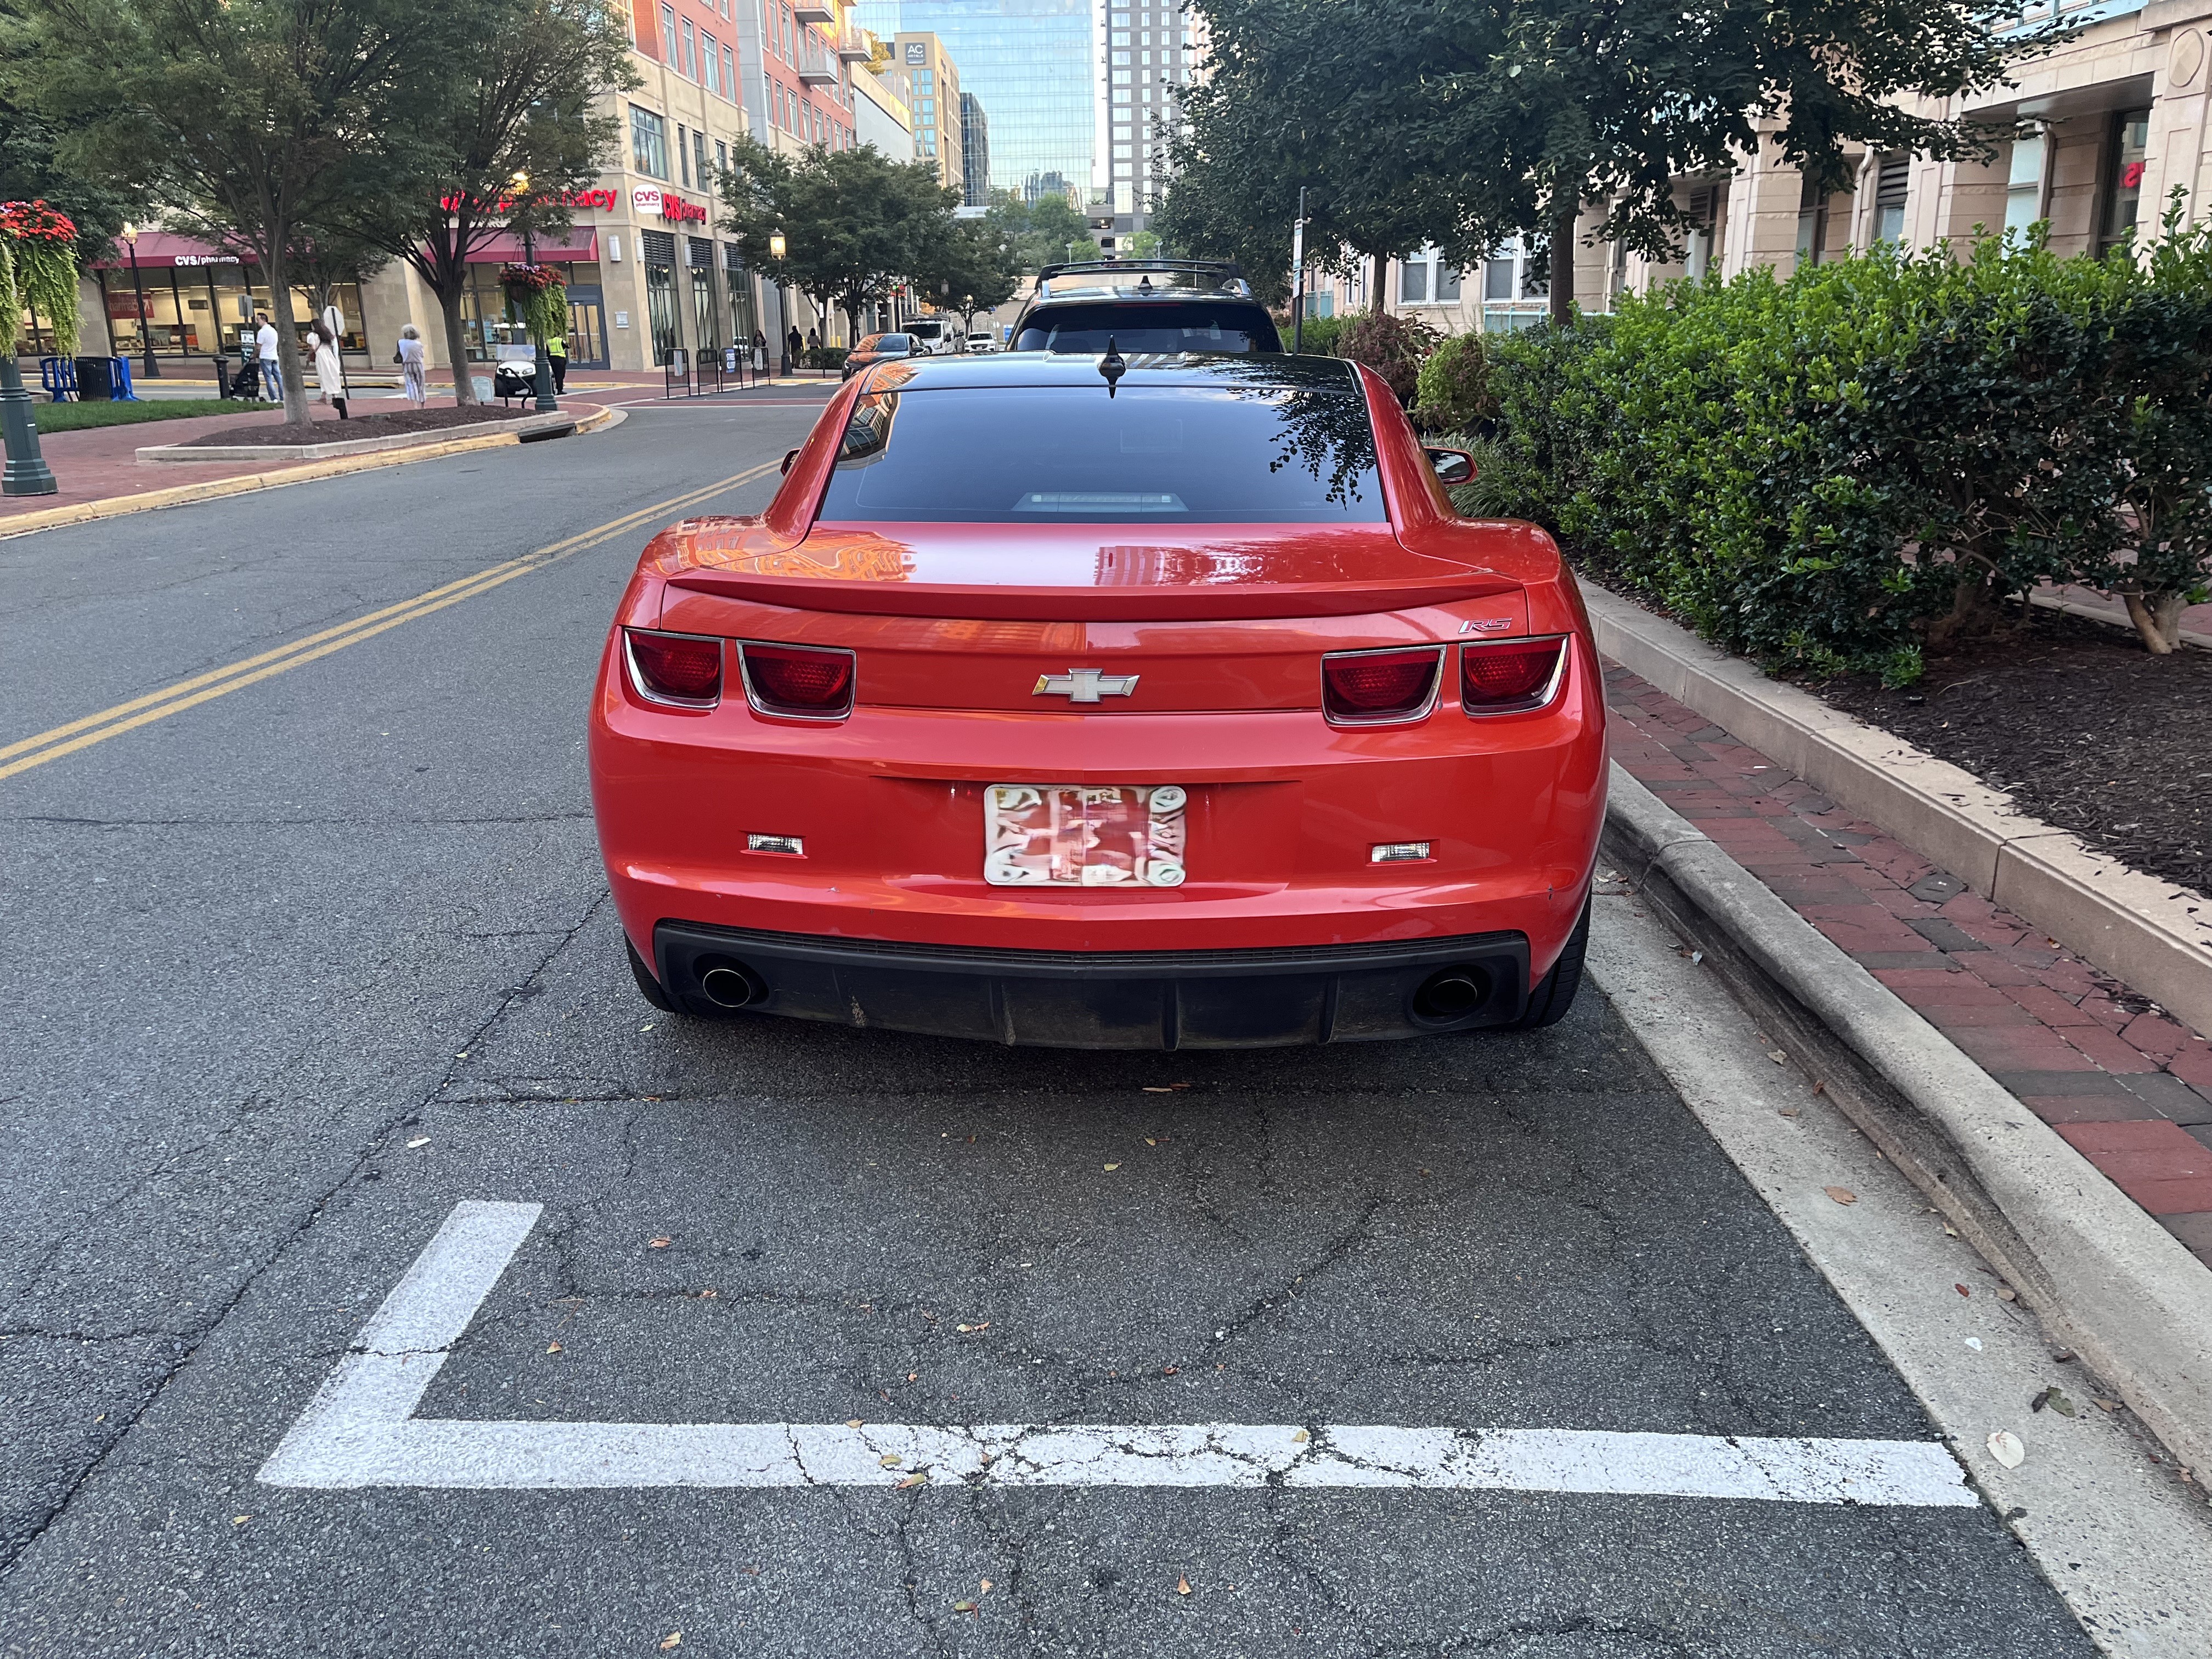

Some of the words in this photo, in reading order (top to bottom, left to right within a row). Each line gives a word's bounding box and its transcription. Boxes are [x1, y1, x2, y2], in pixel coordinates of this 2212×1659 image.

[908, 45, 923, 54] AC
[635, 191, 659, 202] CVS
[1458, 618, 1513, 634] RS
